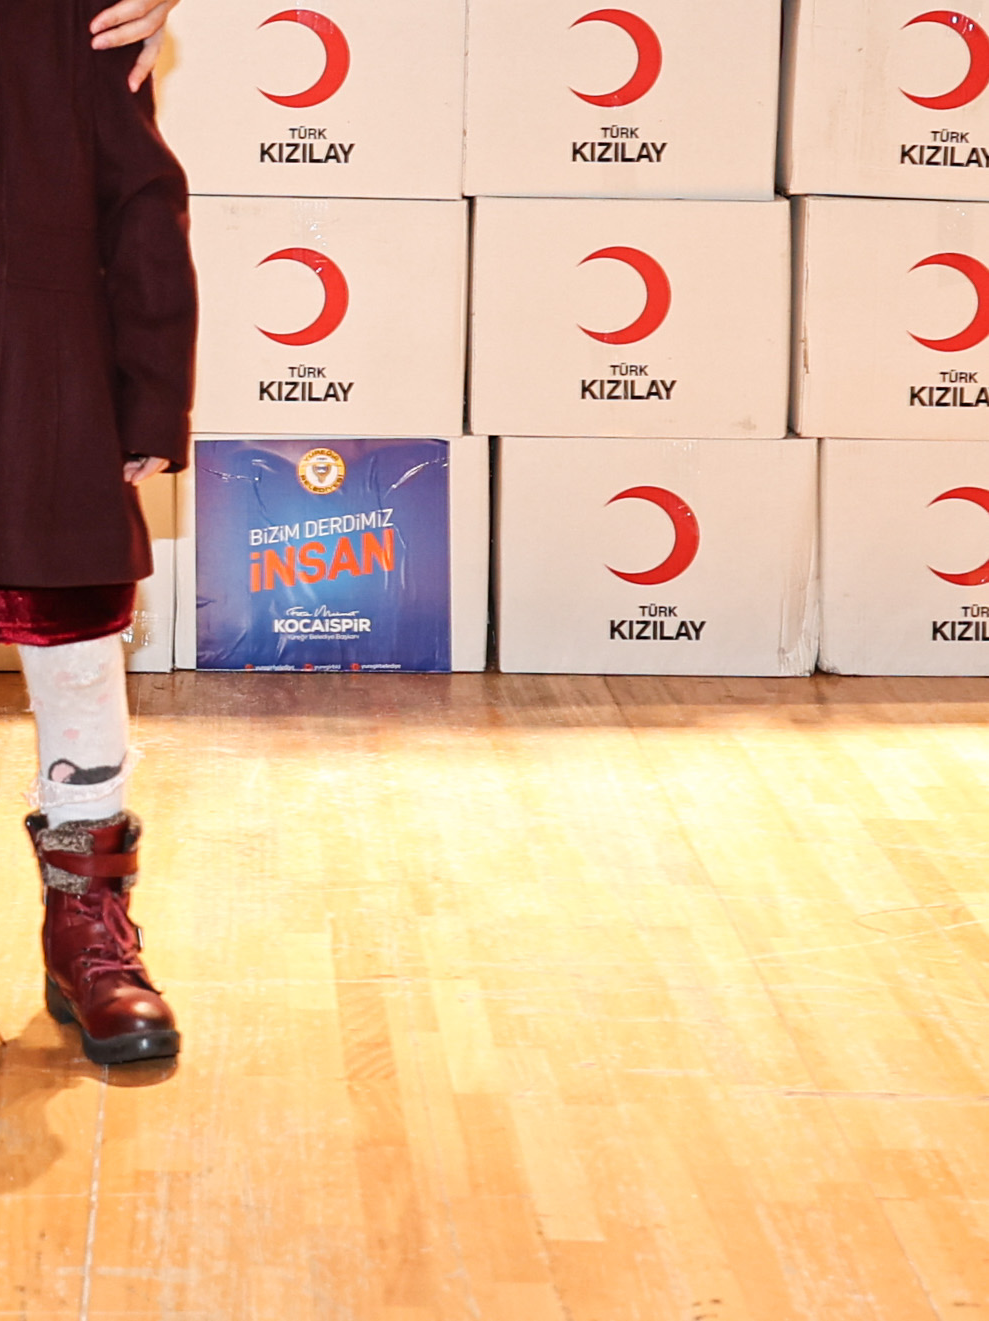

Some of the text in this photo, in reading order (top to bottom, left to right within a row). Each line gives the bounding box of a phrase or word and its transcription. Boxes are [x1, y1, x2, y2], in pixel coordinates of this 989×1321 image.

[288, 126, 327, 140] TÜRK
[600, 125, 639, 139] TÜRK
[930, 129, 970, 143] TÜRK
[259, 142, 356, 164] KIZILAY
[571, 141, 668, 163] KIZILAY
[287, 365, 326, 379] TÜRK
[609, 364, 649, 377] TÜRK
[939, 369, 978, 384] TÜRK
[259, 380, 355, 402] KIZILAY
[580, 379, 677, 401] KIZILAY
[909, 385, 989, 408] KIZILA
[638, 604, 678, 618] TÜRK
[961, 604, 989, 618] TÜR
[609, 619, 707, 641] KIZILAY
